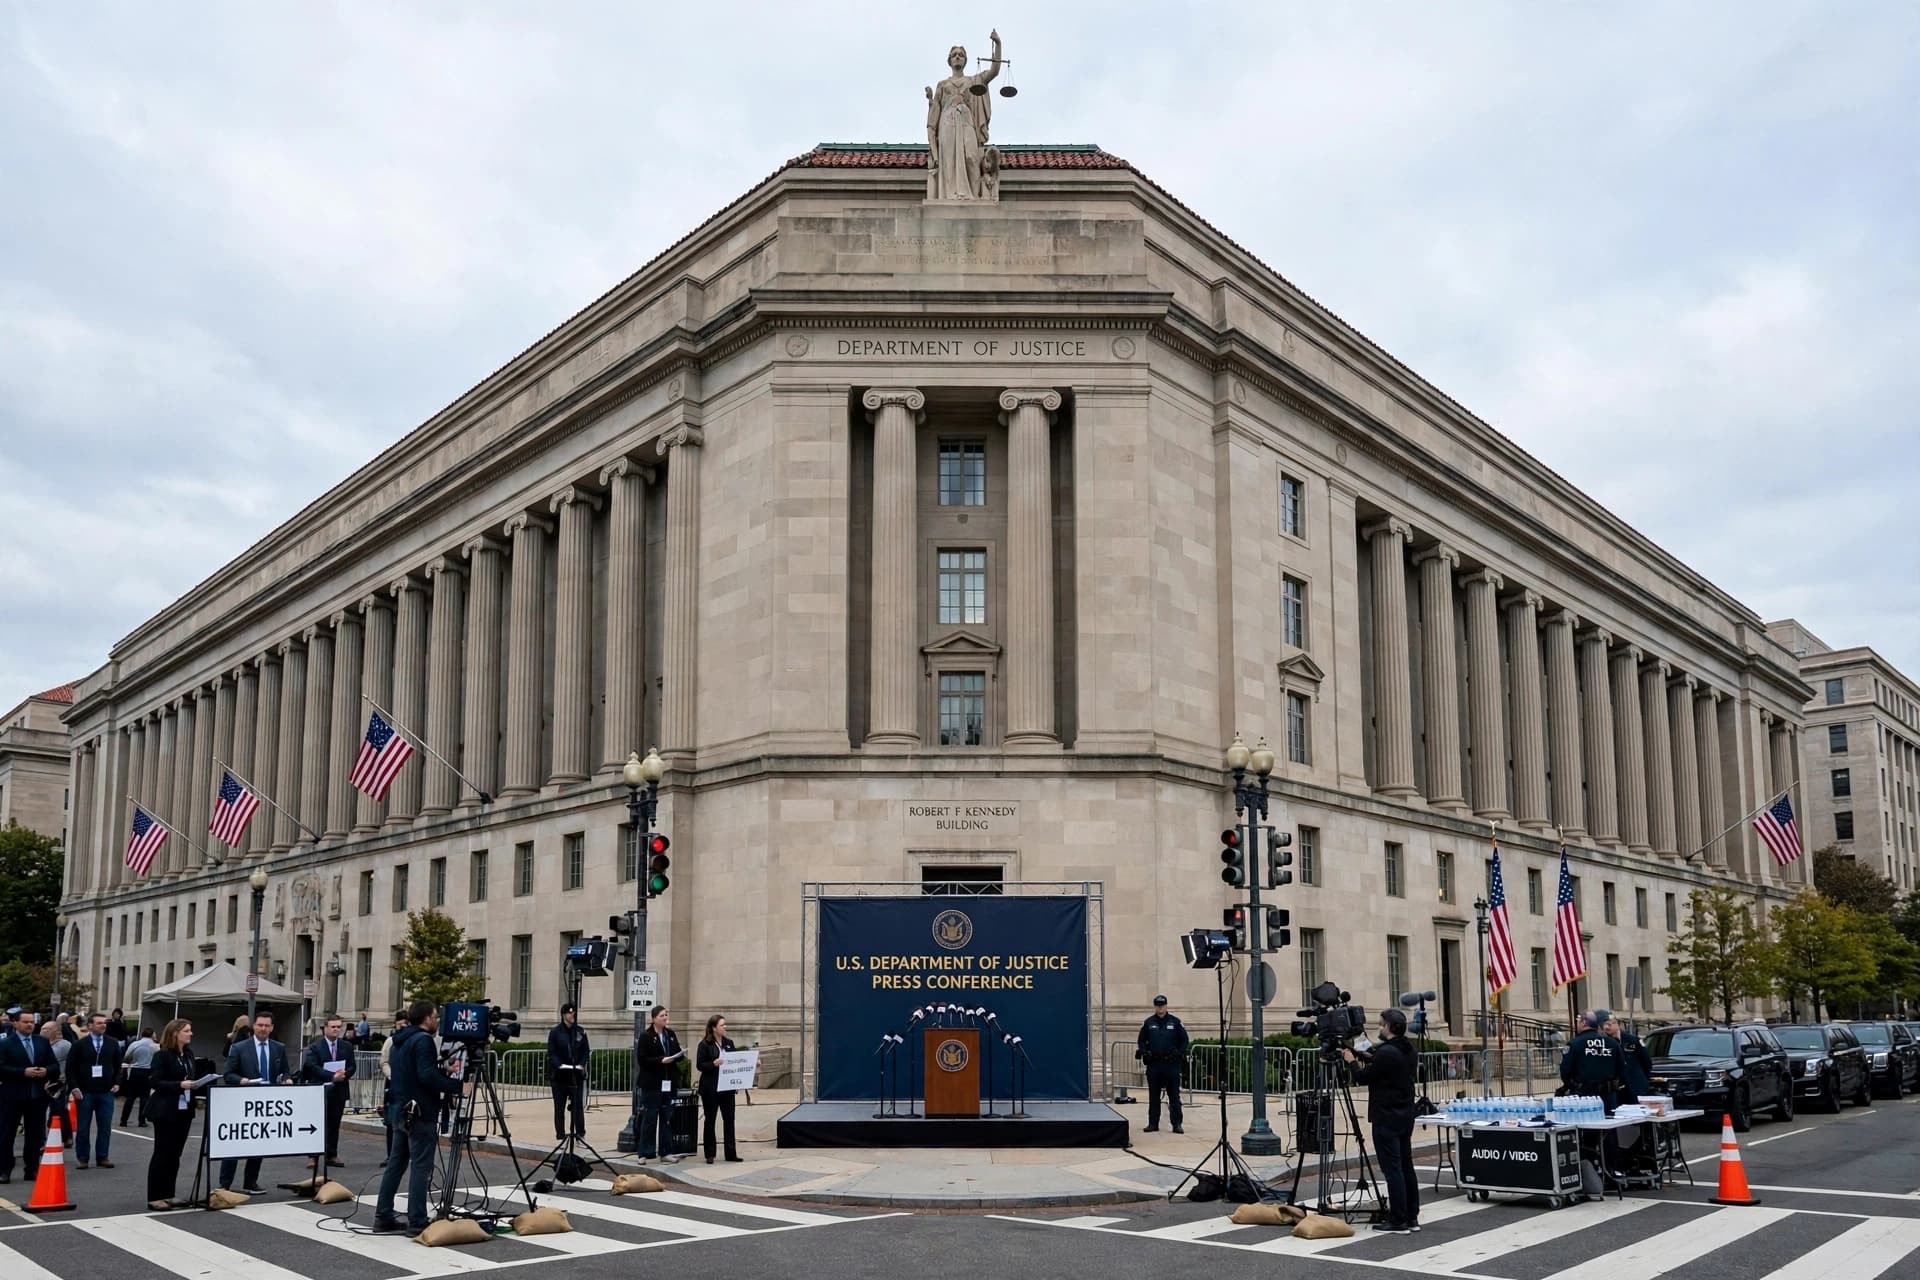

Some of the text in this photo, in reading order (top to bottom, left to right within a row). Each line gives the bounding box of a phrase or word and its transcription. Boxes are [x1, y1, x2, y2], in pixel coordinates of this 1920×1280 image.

[838, 340, 1086, 356] DEPARTMENT OF JUSTICE
[909, 806, 950, 817] ROBERT
[965, 806, 1016, 817] KENNEDY
[936, 820, 989, 830] BUILDING
[835, 955, 1069, 970] U.S. DEPARTMENT OF JUSTICE
[872, 975, 1033, 989] PRESS CONFERENCE
[452, 1021, 479, 1032] NEWS
[244, 1099, 293, 1118] PRESS
[217, 1121, 293, 1141] CHECK-IN
[1471, 1148, 1500, 1160] AUDIO
[1508, 1150, 1538, 1162] VIDEO
